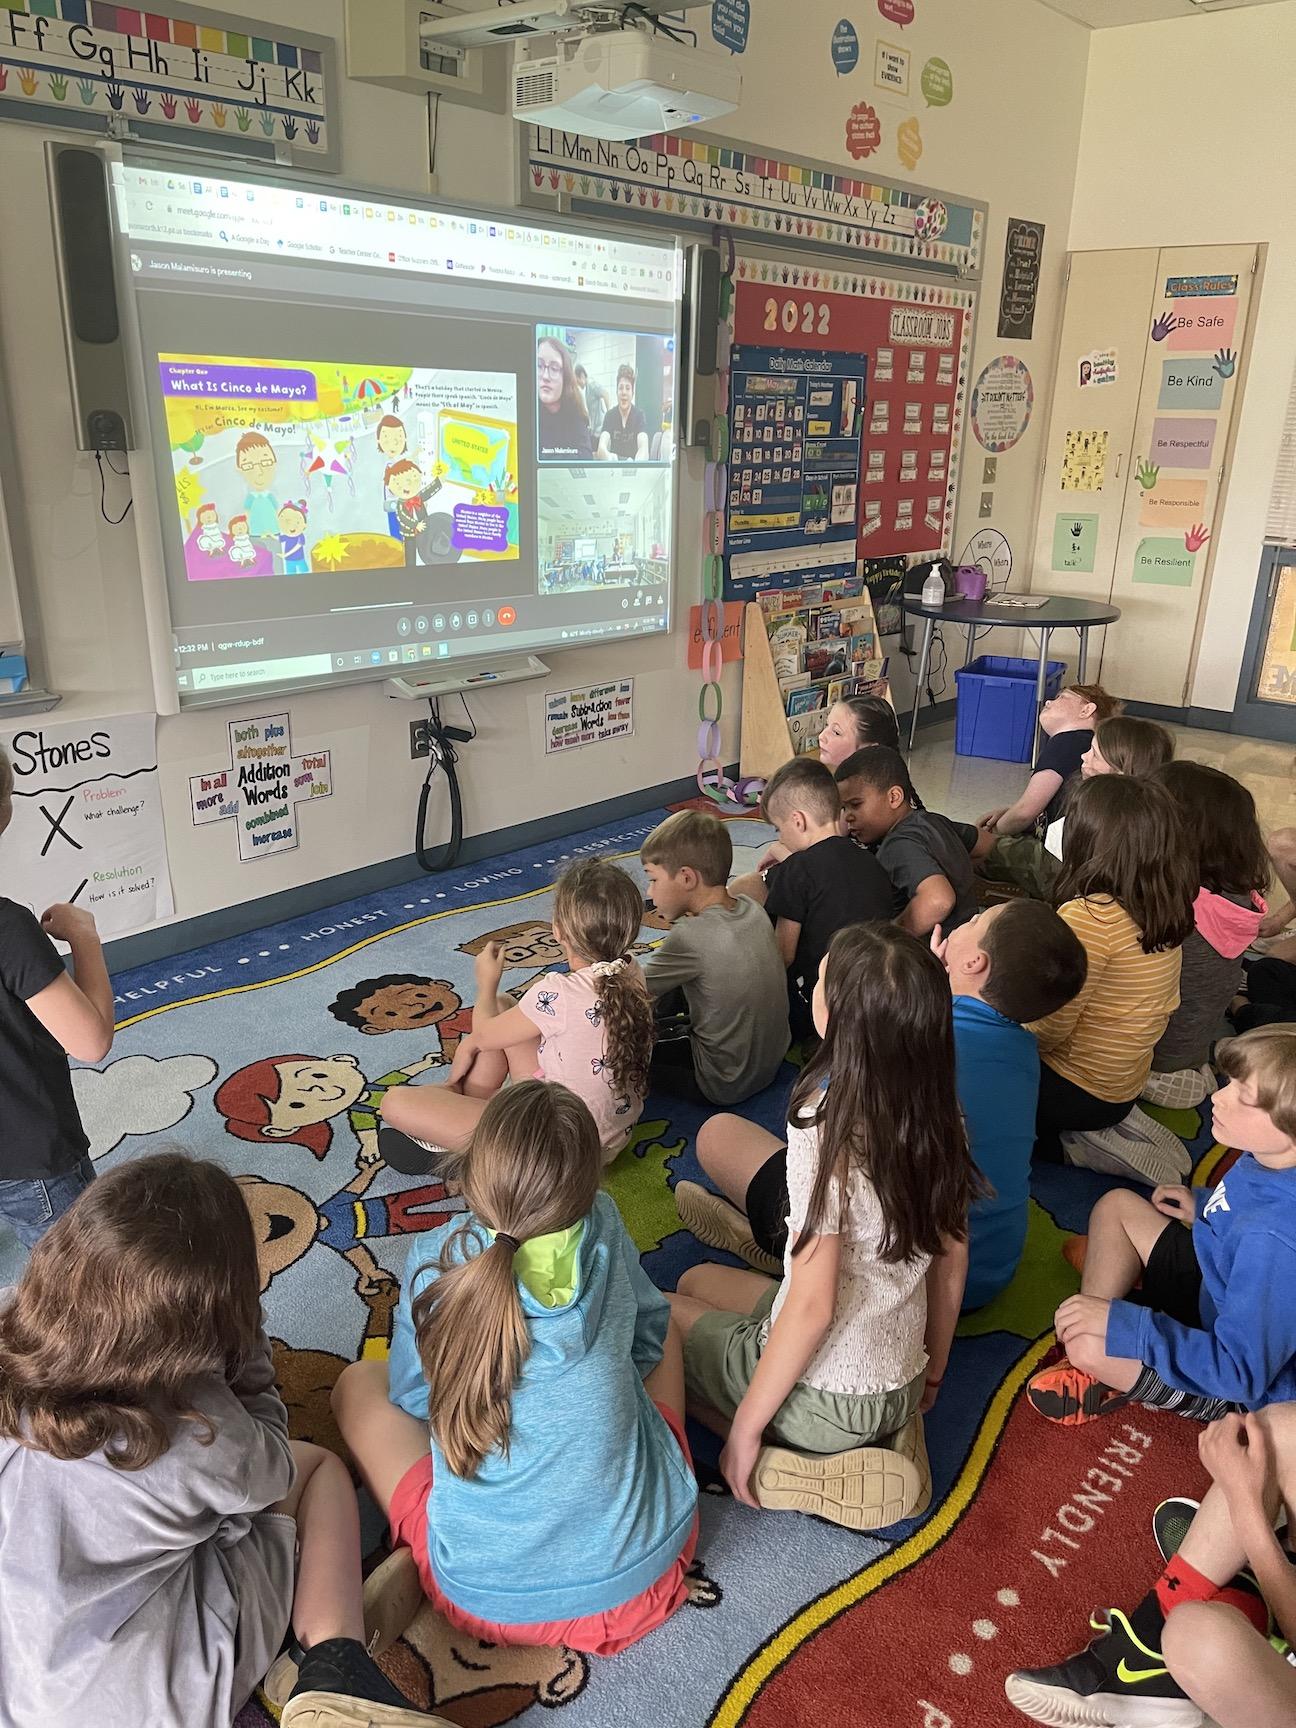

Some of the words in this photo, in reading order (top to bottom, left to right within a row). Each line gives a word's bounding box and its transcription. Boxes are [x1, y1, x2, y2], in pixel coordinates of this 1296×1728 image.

[9, 9, 49, 50] Ff
[68, 24, 115, 79] Gg
[127, 34, 169, 76] Hh
[191, 48, 209, 83] Ii
[237, 59, 267, 106] Jj
[285, 67, 316, 104] Kk
[562, 131, 592, 163] Mm
[598, 139, 618, 169] Nn
[626, 147, 648, 174] Oo
[656, 153, 675, 189] Pp
[683, 160, 703, 195] Qq
[709, 165, 726, 191] Rr
[734, 171, 750, 196] Ss
[760, 177, 773, 200] Tt
[781, 182, 797, 205] Uu
[804, 186, 818, 209] Vv
[822, 189, 840, 213] Ww
[844, 196, 859, 217] Xx
[864, 200, 877, 228] Yy
[882, 204, 896, 225] Zz
[218, 268, 252, 280] presenting
[1170, 282, 1200, 292] Class
[1203, 280, 1234, 291] Rules
[764, 298, 830, 335] 2022
[1178, 318, 1193, 328] Be
[1198, 317, 1225, 328] Safe
[169, 368, 194, 376] Chapter
[171, 380, 203, 391] What
[207, 381, 217, 392] Is
[221, 382, 252, 393] Cinco
[255, 384, 267, 394] de
[271, 384, 307, 398] Mayo?
[1168, 376, 1183, 387] Be
[1187, 376, 1213, 387] Kind
[215, 416, 246, 427] Cinco
[249, 418, 261, 429] de
[264, 424, 296, 437] Mayo!
[1158, 440, 1168, 448] Be
[1170, 440, 1209, 449] Respectful
[1141, 557, 1151, 565] Be
[1154, 558, 1191, 567] Resilient
[571, 700, 612, 718] Subtraction
[580, 714, 604, 731] Words
[234, 725, 259, 743] both
[264, 724, 285, 741] plus
[12, 731, 111, 776] Stones
[237, 744, 287, 760] altogether
[302, 754, 327, 770] total
[238, 762, 290, 788] Addition
[294, 772, 314, 787] sum
[83, 788, 127, 803] Problem
[196, 792, 224, 810] more
[242, 781, 288, 806] Words
[107, 801, 145, 817] challenge?
[219, 800, 239, 815] add
[246, 804, 289, 831] combined
[252, 828, 293, 846] increase
[93, 866, 143, 882] Resolution
[453, 868, 524, 892] LOVING
[90, 894, 105, 903] How
[109, 890, 116, 898] is
[118, 886, 124, 896] it
[128, 878, 155, 893] solved?
[301, 909, 389, 942] HONEST
[114, 965, 223, 1004] HELPFUL
[1030, 1424, 1153, 1578] FRIENDLY
